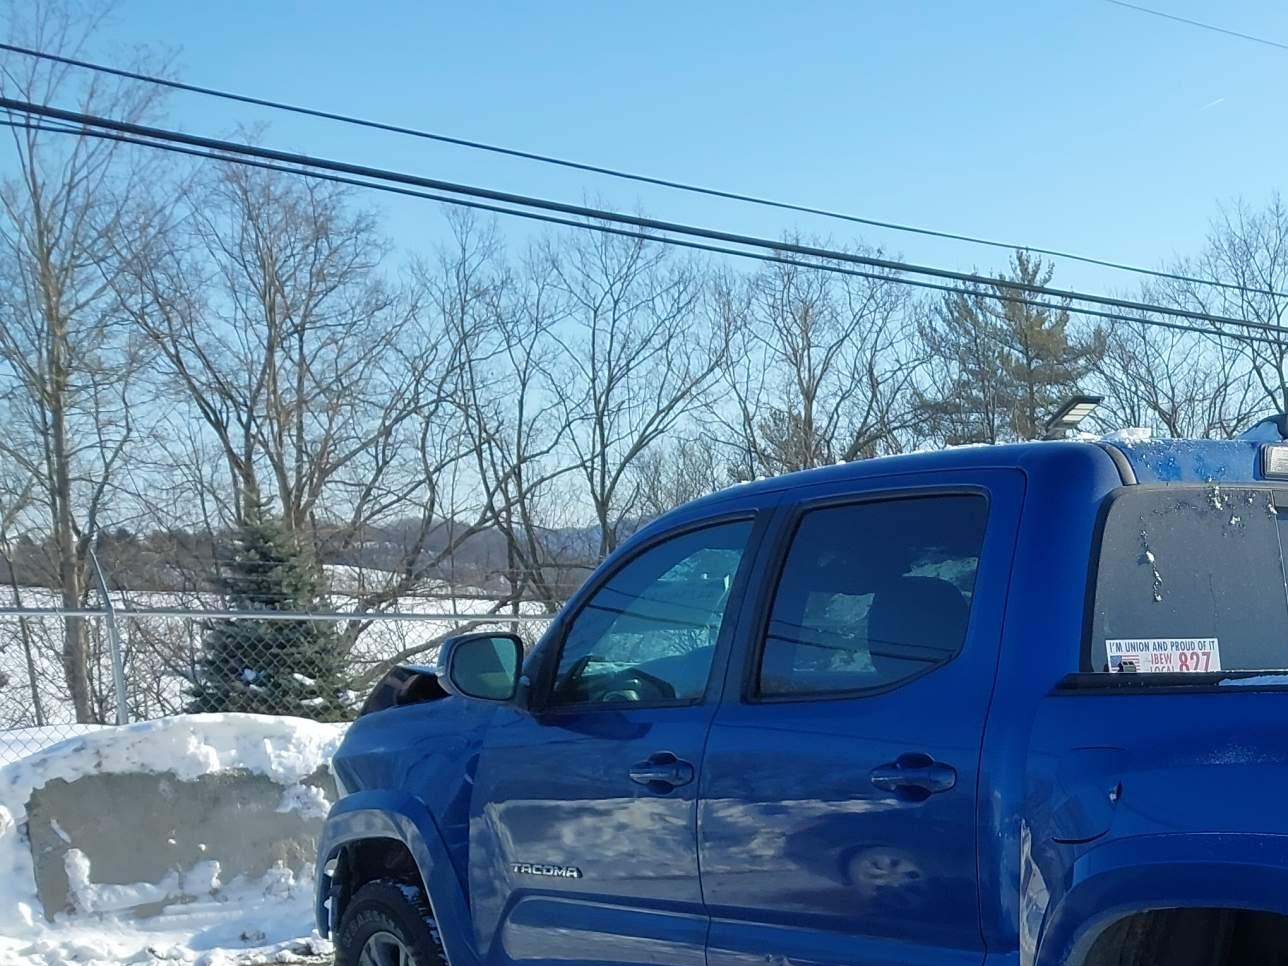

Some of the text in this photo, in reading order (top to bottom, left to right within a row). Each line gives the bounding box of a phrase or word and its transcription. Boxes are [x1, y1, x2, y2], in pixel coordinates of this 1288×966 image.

[1109, 640, 1215, 653] I'M UNION AND PROUD OF IT
[1150, 653, 1172, 665] IBEW
[1178, 651, 1212, 672] 827
[510, 863, 580, 879] TACOMA
